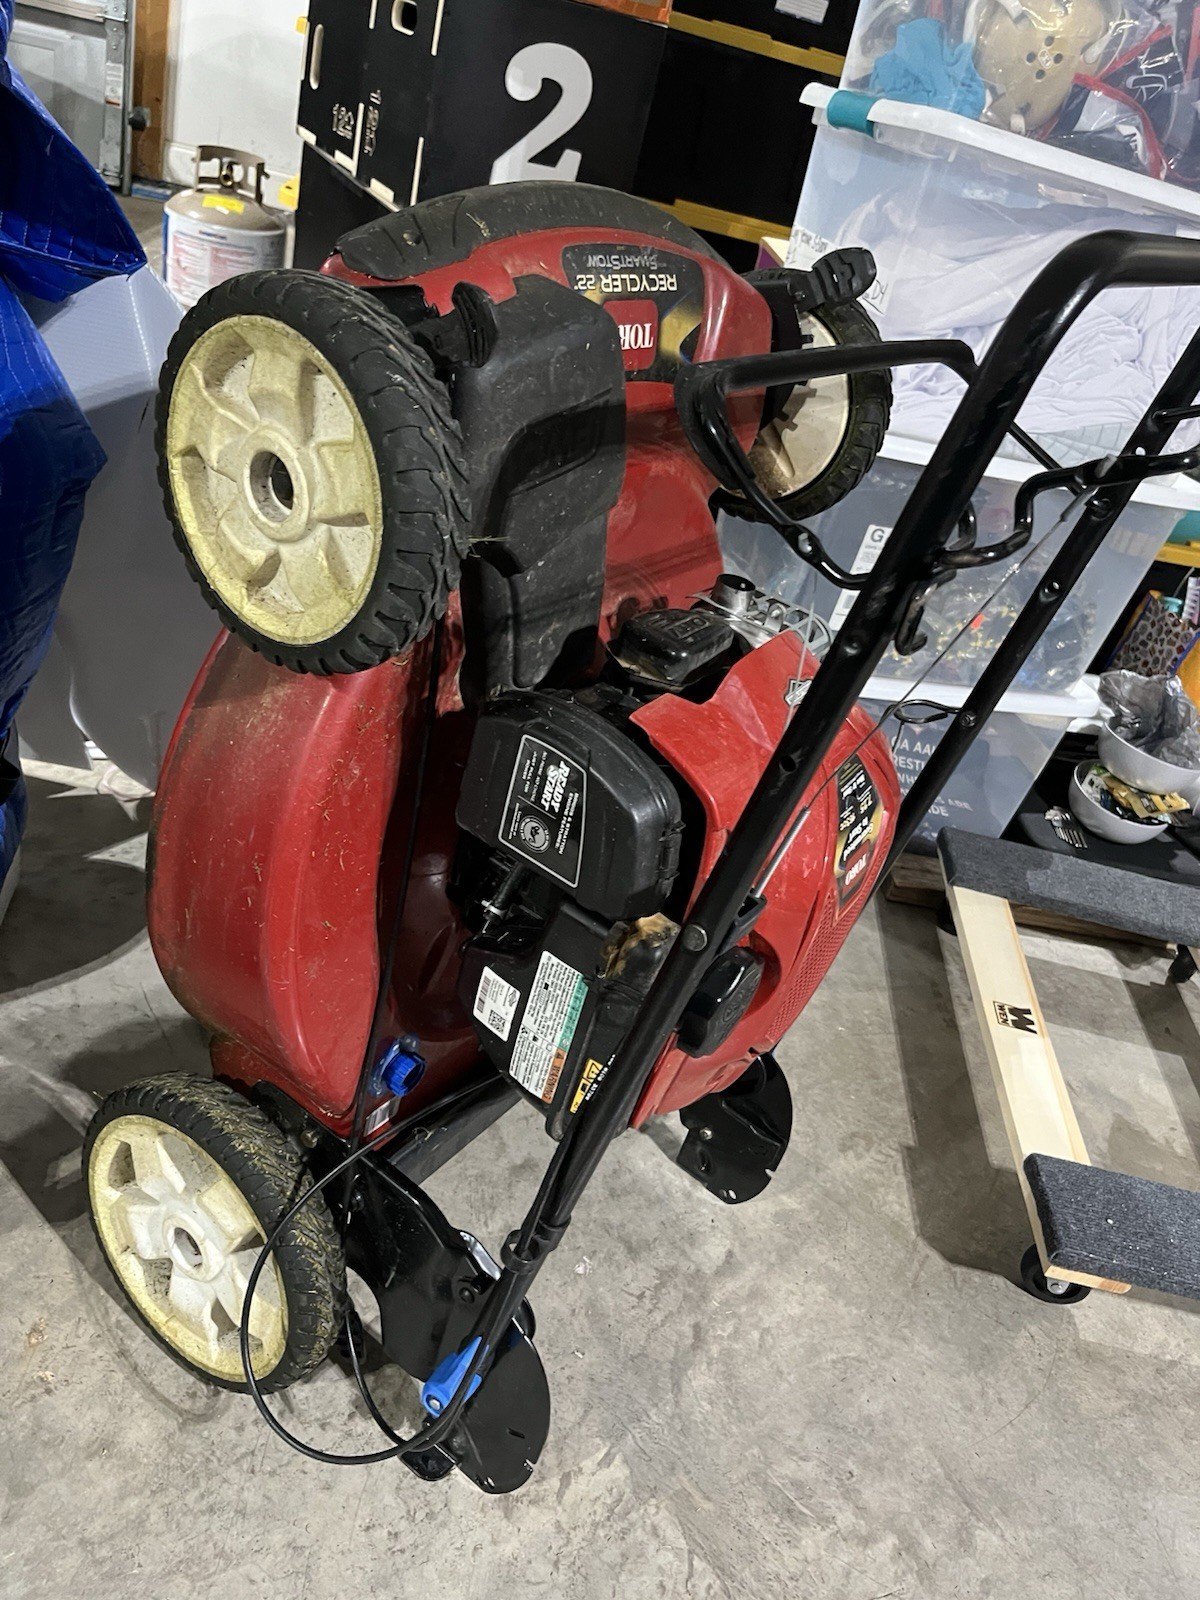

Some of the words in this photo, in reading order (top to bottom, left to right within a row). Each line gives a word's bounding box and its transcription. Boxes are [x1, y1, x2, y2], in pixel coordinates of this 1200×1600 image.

[489, 42, 593, 185] 2
[600, 274, 678, 292] RECYCLER
[618, 323, 654, 350] TOR
[540, 764, 560, 812] START
[551, 760, 571, 813] READY
[845, 853, 867, 886] TORO
